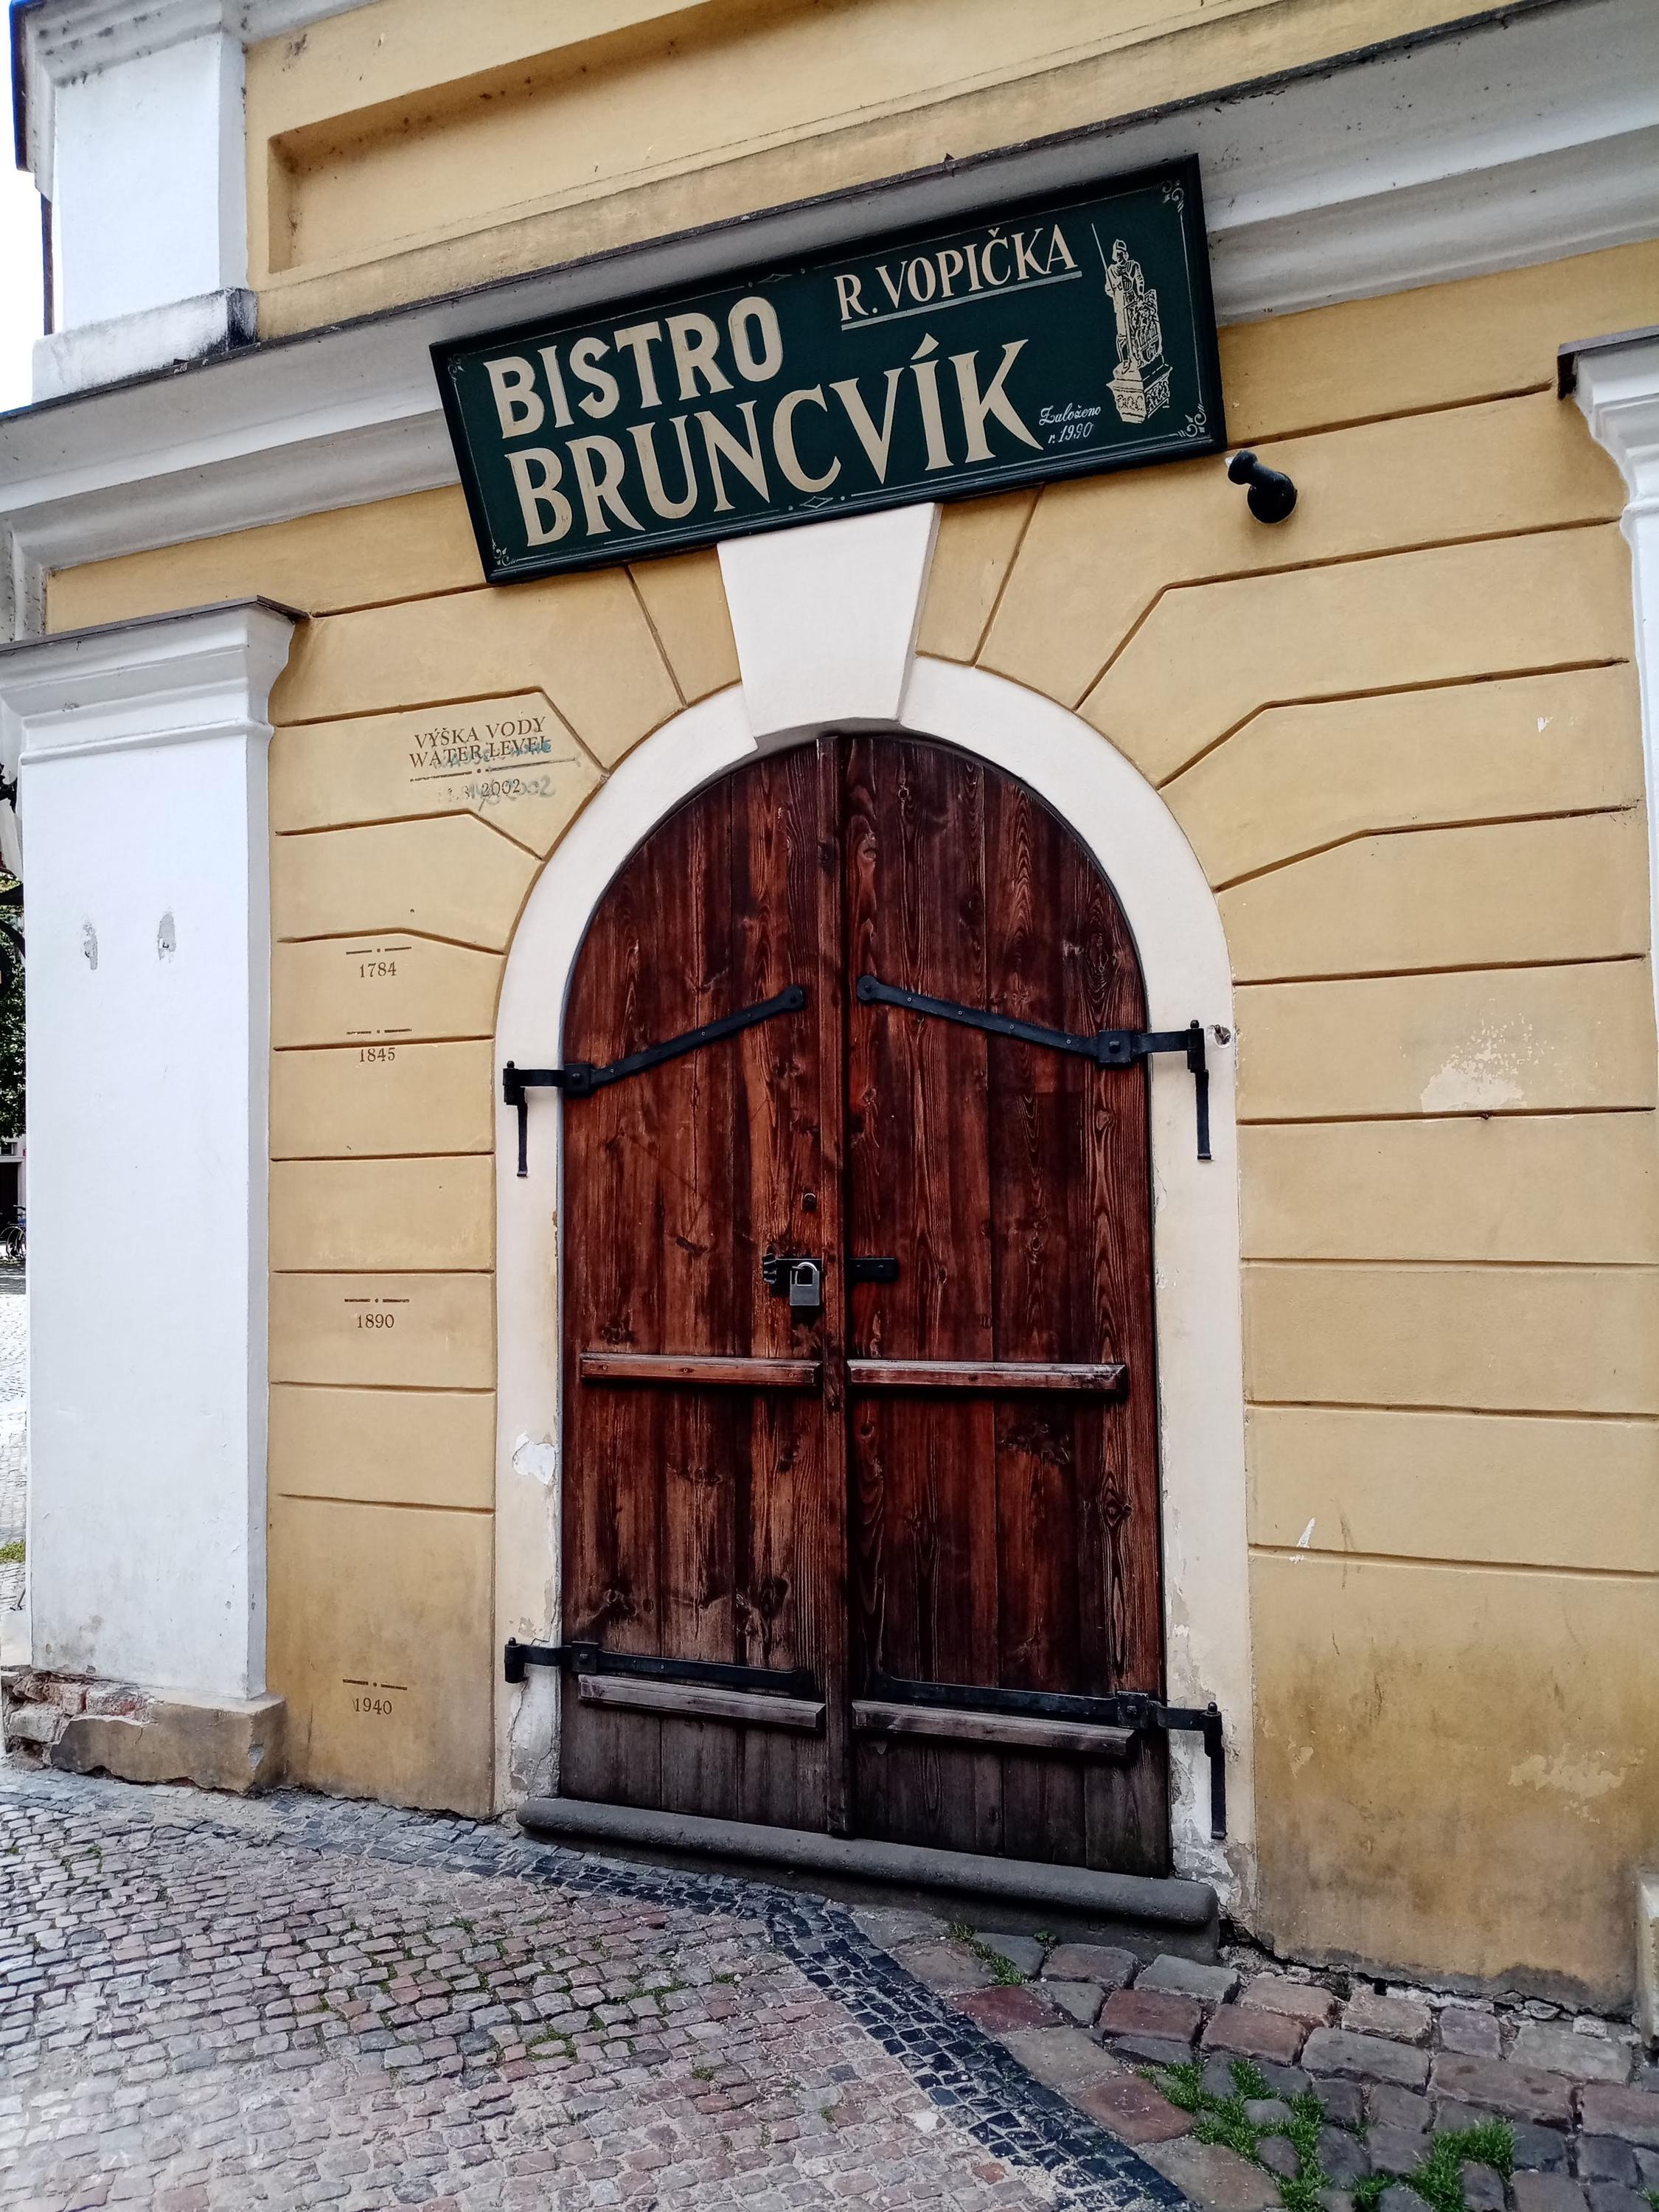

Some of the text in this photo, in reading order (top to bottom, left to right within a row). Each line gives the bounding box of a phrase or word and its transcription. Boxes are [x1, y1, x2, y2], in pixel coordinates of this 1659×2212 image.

[483, 296, 784, 439] BISTRO
[1039, 403, 1101, 425] Založeno
[505, 333, 1043, 547] BRUNCVÍK
[1058, 422, 1095, 443] 1990
[414, 717, 546, 749] VÝŠKA VODY
[409, 736, 549, 768] WATER LEVEL
[481, 779, 521, 797] 2002
[360, 961, 396, 978] 1784
[360, 1047, 395, 1062] 1845
[358, 1313, 394, 1328] 1890
[355, 1697, 392, 1714] 1940
